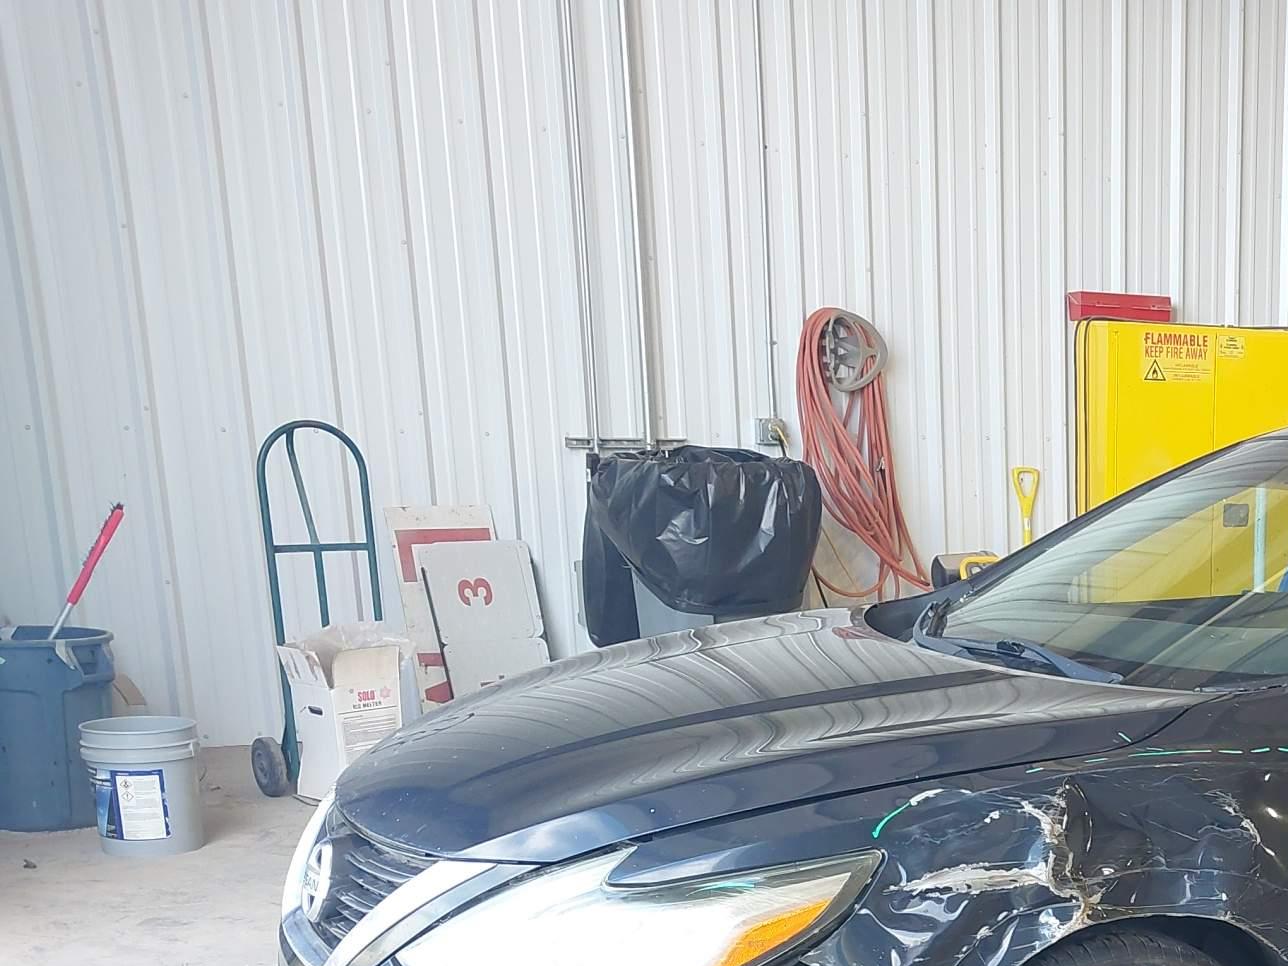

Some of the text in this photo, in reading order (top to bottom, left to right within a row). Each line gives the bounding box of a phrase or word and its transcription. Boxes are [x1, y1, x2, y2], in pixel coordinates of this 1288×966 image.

[1144, 332, 1208, 347] FLAMMABLE
[1144, 345, 1208, 360] KEEP FIRE AWAY
[458, 577, 493, 606] 3
[357, 690, 376, 702] SOLO
